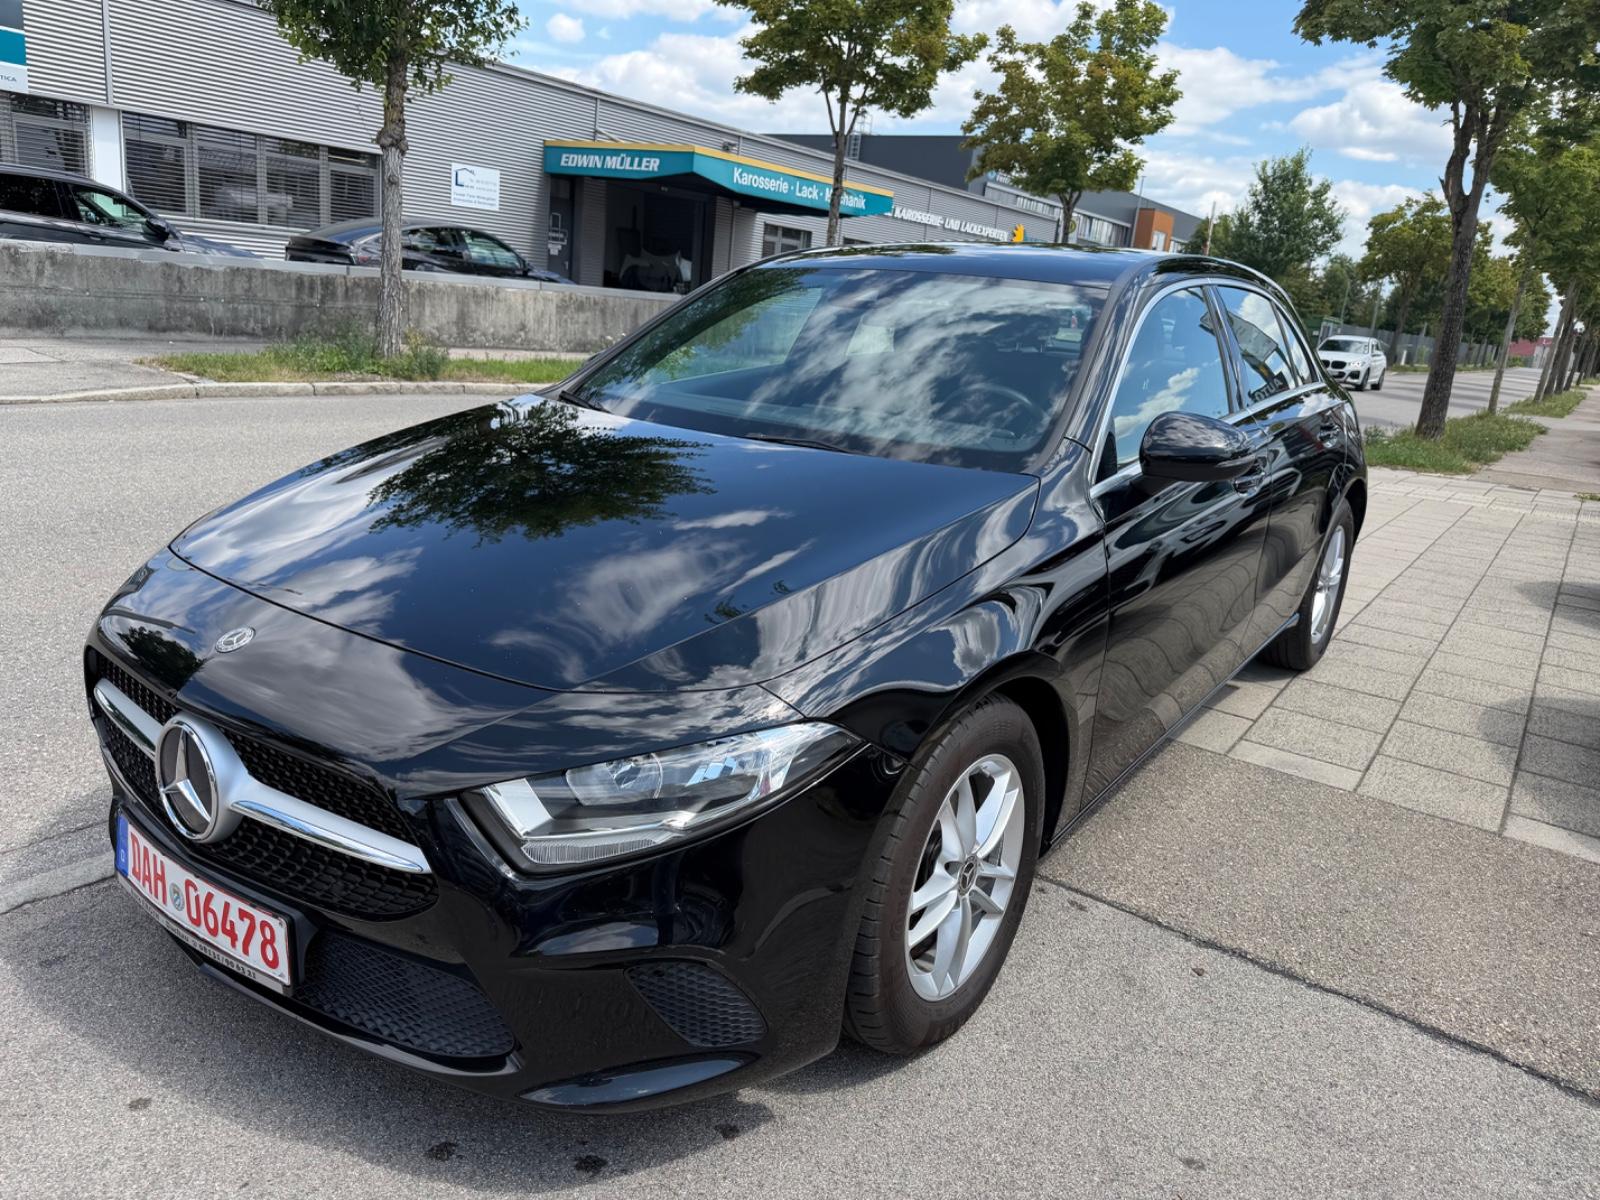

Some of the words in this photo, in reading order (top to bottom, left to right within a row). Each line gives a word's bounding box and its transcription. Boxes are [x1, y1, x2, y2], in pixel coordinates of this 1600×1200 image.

[560, 153, 603, 169] EDWIN
[603, 153, 660, 171] MÜLLER
[733, 167, 789, 194] Karosserie
[795, 181, 818, 200] Lack
[825, 187, 866, 210] Mchanik
[130, 831, 168, 905] DAH
[184, 878, 280, 970] 06478
